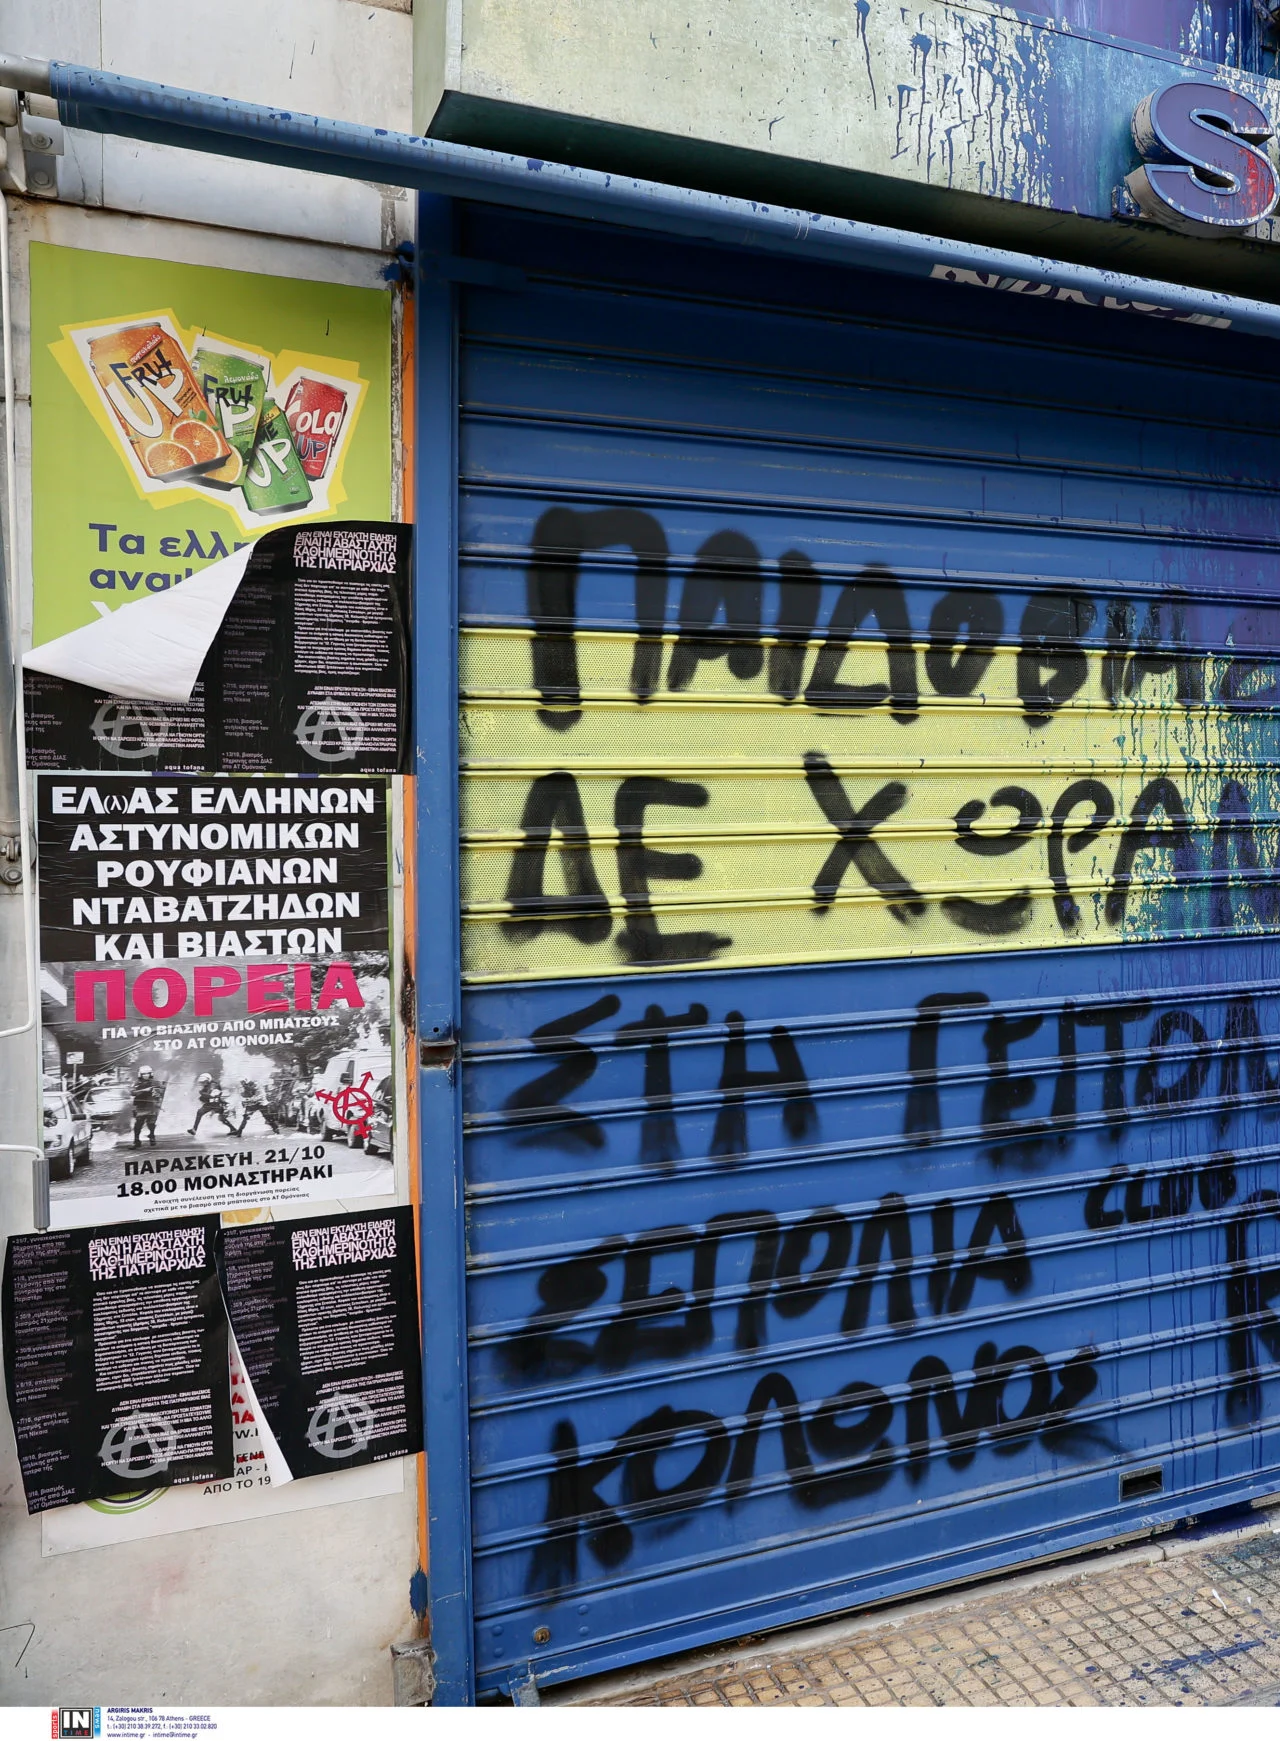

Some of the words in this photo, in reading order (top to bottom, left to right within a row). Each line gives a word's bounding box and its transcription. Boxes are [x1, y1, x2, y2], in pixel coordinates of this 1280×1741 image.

[106, 368, 185, 438] UP
[297, 436, 328, 461] UP
[247, 438, 292, 488] UP
[89, 523, 146, 555] Τα
[294, 537, 322, 547] ΕΙΝΑΙ
[325, 539, 332, 547] Η
[333, 539, 397, 552] ΑΒΑΣΤΑΧΤΗ
[296, 531, 311, 539] ΔΕΝ
[312, 531, 332, 539] ΕΙΝΑΙ
[333, 532, 368, 541] ΕΚΤΑΚΤΗ
[370, 533, 397, 542] ΕΙΔΗΣΗ
[293, 546, 397, 563] ΚΑΘΗΜΕΡΙΝΟΤΗΤΑ
[293, 555, 318, 569] ΤΗΣ
[318, 557, 397, 574] ΠΑΤΡΙΑΡΧΙΑΣ
[52, 786, 180, 815] ΕΛ(λ)ΑΣ
[192, 785, 375, 814] ΕΛΛΗΝΩΝ
[69, 821, 359, 852] ΑΣΤΥΝΟΜΙΚΩΝ
[97, 857, 338, 889] ΡΟΥΦΙΑΝΩΝ
[505, 772, 732, 963] ΔΕ
[72, 891, 360, 926] ΝΤΑΒΑΤΖΗΔΩΝ
[95, 932, 165, 961] ΚΑΙ
[175, 927, 343, 959] ΒΙΑΣΤΩΝ
[74, 960, 366, 1023] ΠΟΡΕΙΑ
[102, 1027, 127, 1039] ΓΙΑ
[132, 1025, 152, 1037] ΤΟ
[156, 1023, 218, 1036] ΒΙΑΣΜΟ
[223, 1021, 255, 1033] ΑΠΟ
[259, 1015, 340, 1030] ΜΠΑΤΣΟΥΣ
[153, 1039, 181, 1051] ΣΤΟ
[187, 1038, 207, 1049] ΑΤ
[211, 1033, 294, 1047] ΟΜΟΝΟΙΑΣ
[264, 1145, 326, 1166] 21/10
[116, 1178, 178, 1198] 18.00
[184, 1164, 334, 1192] ΜΟΝΑΣΤΗΡΑΚΙ
[143, 1206, 169, 1214] σχετικά
[189, 1201, 212, 1210] βιασμό
[213, 1200, 226, 1208] από
[227, 1196, 258, 1206] μπάτσους
[280, 1192, 310, 1203] Ομόνοιας
[153, 1197, 179, 1206] Ανοιχτή
[181, 1193, 214, 1204] συνέλευση
[216, 1192, 226, 1201] για
[235, 1187, 273, 1199] διοργάνωση
[275, 1185, 300, 1194] πορείας
[88, 1238, 108, 1248] ΔΕΝ
[108, 1236, 132, 1246] ΕΙΝΑΙ
[132, 1231, 173, 1243] ΕΚΤΑΚΤΗ
[174, 1227, 205, 1238] ΕΙΔΗΣΗ
[291, 1230, 308, 1239] ΔΕΝ
[309, 1227, 330, 1236] ΕΙΝΑΙ
[330, 1222, 367, 1234] ΕΚΤΑΚΤΗ
[367, 1218, 396, 1229] ΕΙΔΗΣΗ
[292, 1235, 320, 1248] ΕΙΝΑΙ
[321, 1234, 330, 1244] Η
[332, 1226, 396, 1243] ΑΒΑΣΤΑΧΤΗ
[89, 1245, 121, 1259] ΕΙΝΑΙ
[122, 1243, 132, 1253] Η
[134, 1235, 205, 1252] ΑΒΑΣΤΑΧΤΗ
[89, 1247, 206, 1270] ΚΑΘΗΜΕΡΙΝΟΤΗΤΑ
[292, 1238, 397, 1260] ΚΑΘΗΜΕΡΙΝΟΤΗΤΑ
[293, 1256, 317, 1271] ΤΗΣ
[319, 1247, 397, 1268] ΠΑΤΡΙΑΡΧΙΑΣ
[90, 1267, 117, 1281] ΤΗΣ
[119, 1257, 206, 1278] ΠΑΤΡΙΑΡΧΙΑΣ
[502, 1190, 1033, 1378] ΣΕΠΟΛΙΑ
[373, 1453, 388, 1461] aqua
[389, 1449, 409, 1457] tofana
[203, 1483, 232, 1495] ΑΠΟ
[238, 1480, 253, 1490] ΤΟ
